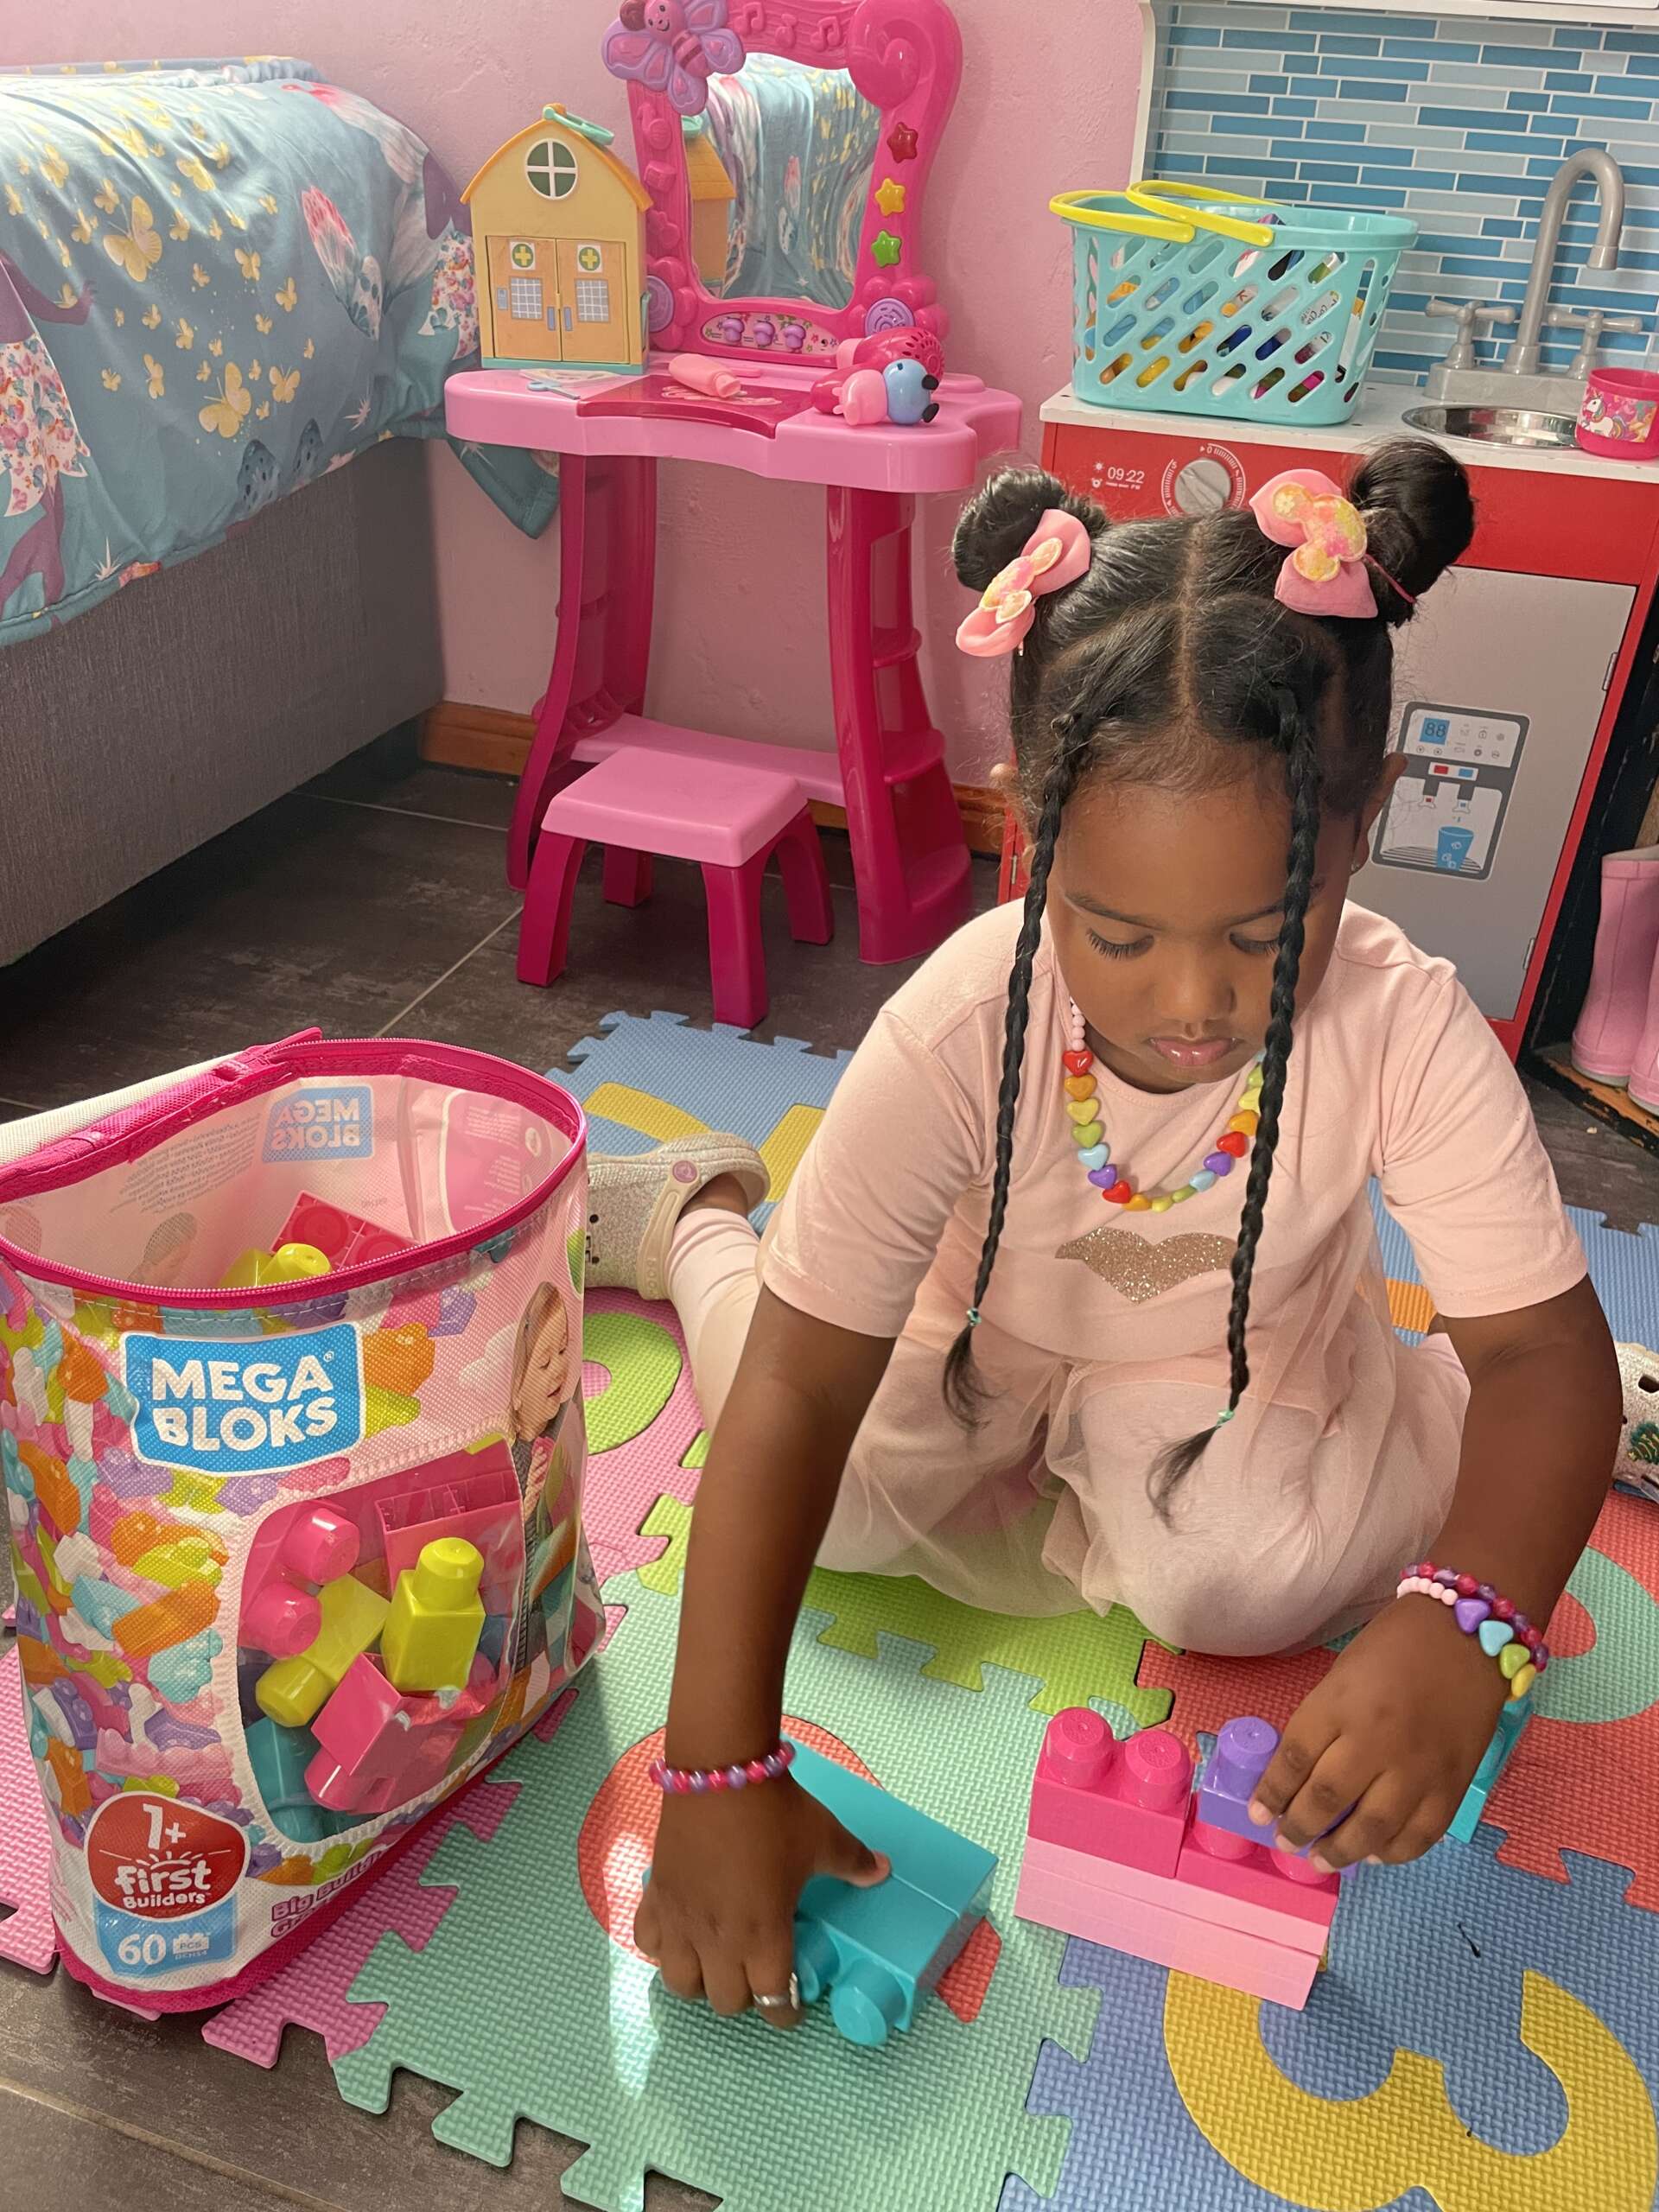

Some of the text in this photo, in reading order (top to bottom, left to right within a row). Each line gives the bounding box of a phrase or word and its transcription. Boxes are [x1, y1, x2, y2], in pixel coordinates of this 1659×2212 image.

[1426, 721, 1446, 738] 88
[152, 1355, 334, 1403] MEGA
[152, 1396, 338, 1452] BLOKS
[143, 1803, 187, 1850] 1+
[123, 1892, 207, 1909] Builders
[271, 1894, 314, 1922] Big
[118, 1933, 167, 1965] 60
